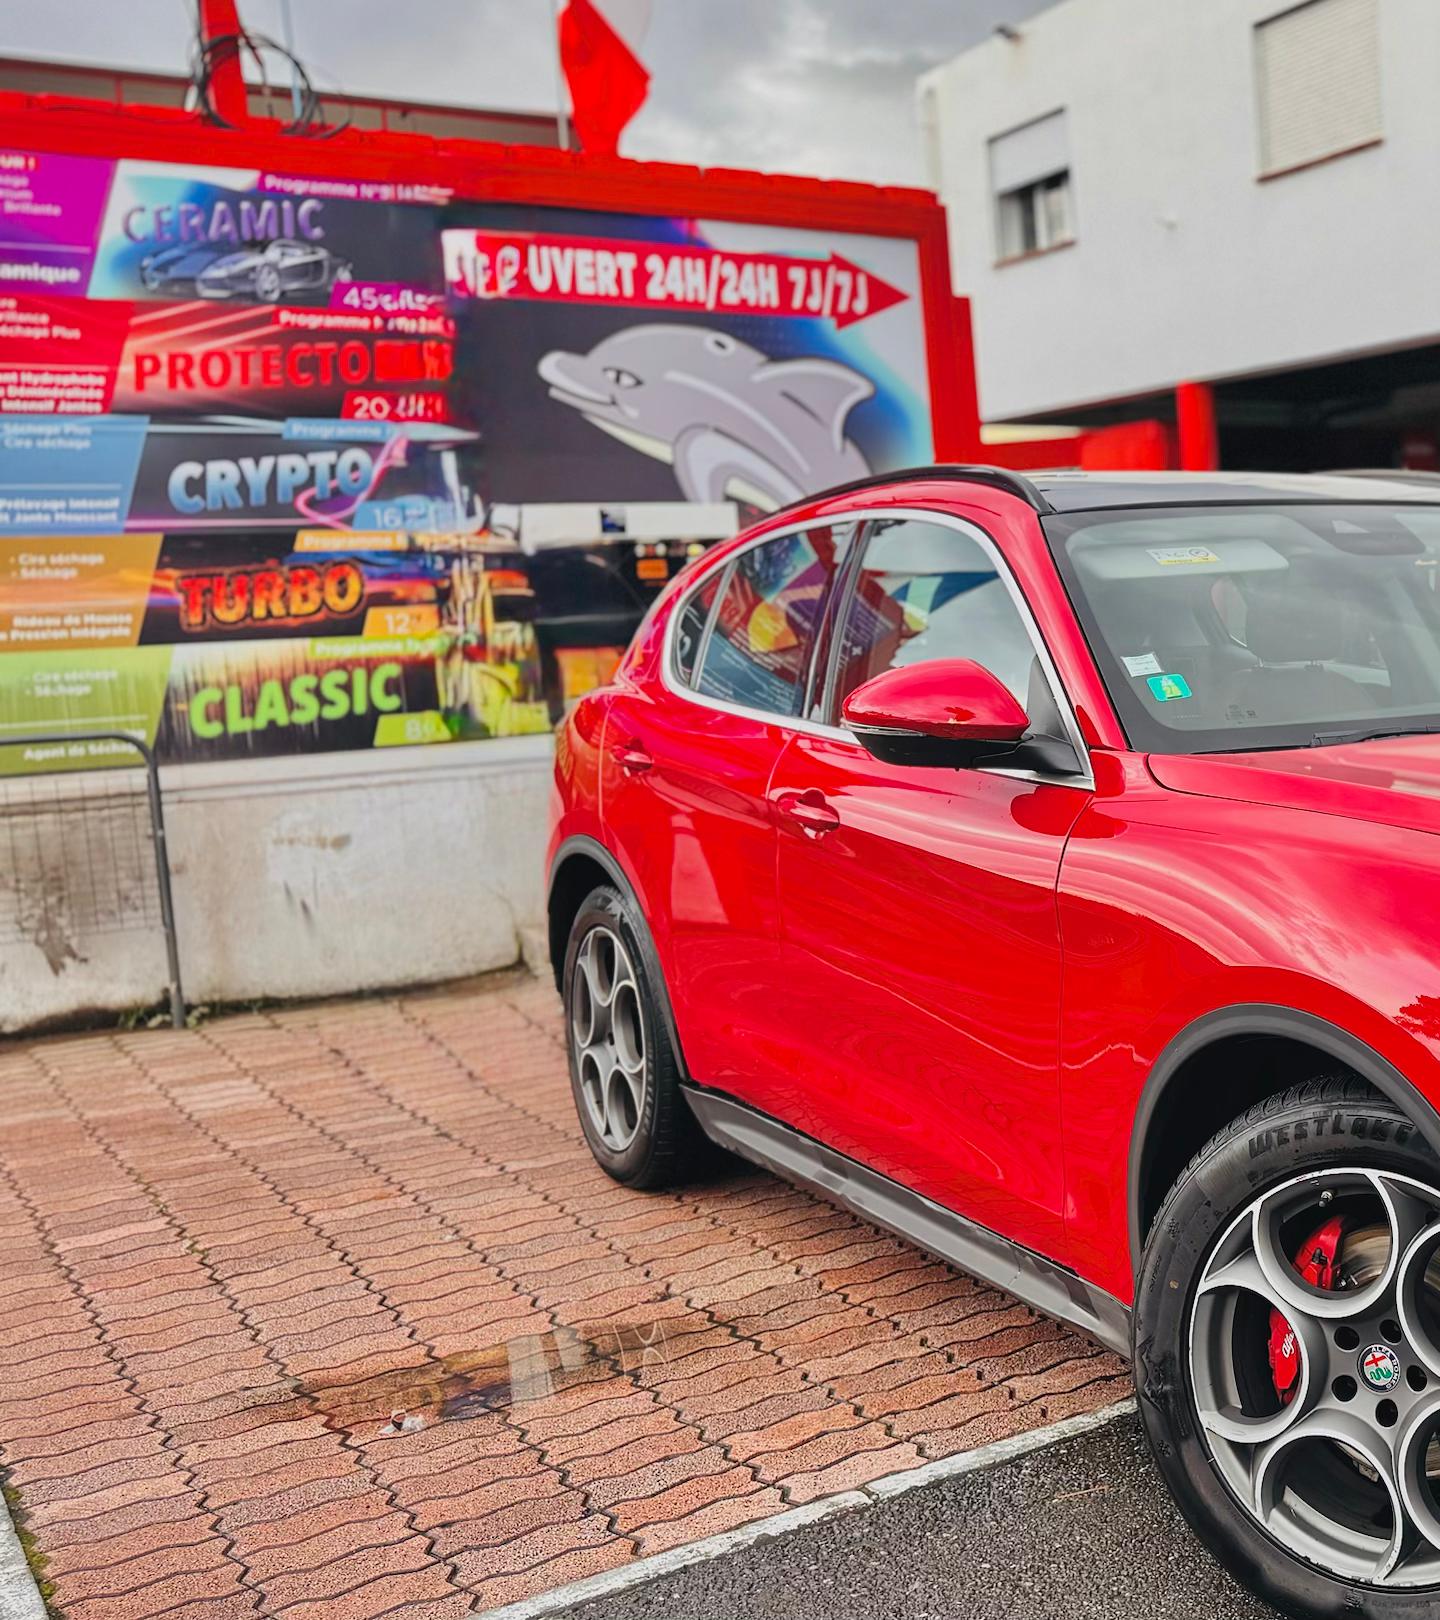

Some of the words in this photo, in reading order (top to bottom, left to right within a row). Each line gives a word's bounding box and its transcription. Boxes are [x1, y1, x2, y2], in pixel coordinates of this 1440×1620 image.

[264, 174, 358, 197] Programme
[122, 198, 325, 243] CERAMIC
[644, 254, 780, 311] 24H/24H
[787, 264, 868, 317] 7J/7J
[279, 310, 371, 330] Programme
[168, 447, 374, 513] CRYPTO
[178, 562, 363, 627] TURBO
[189, 663, 402, 739] CLASSIC
[1248, 1112, 1414, 1159] WESTLAKE
